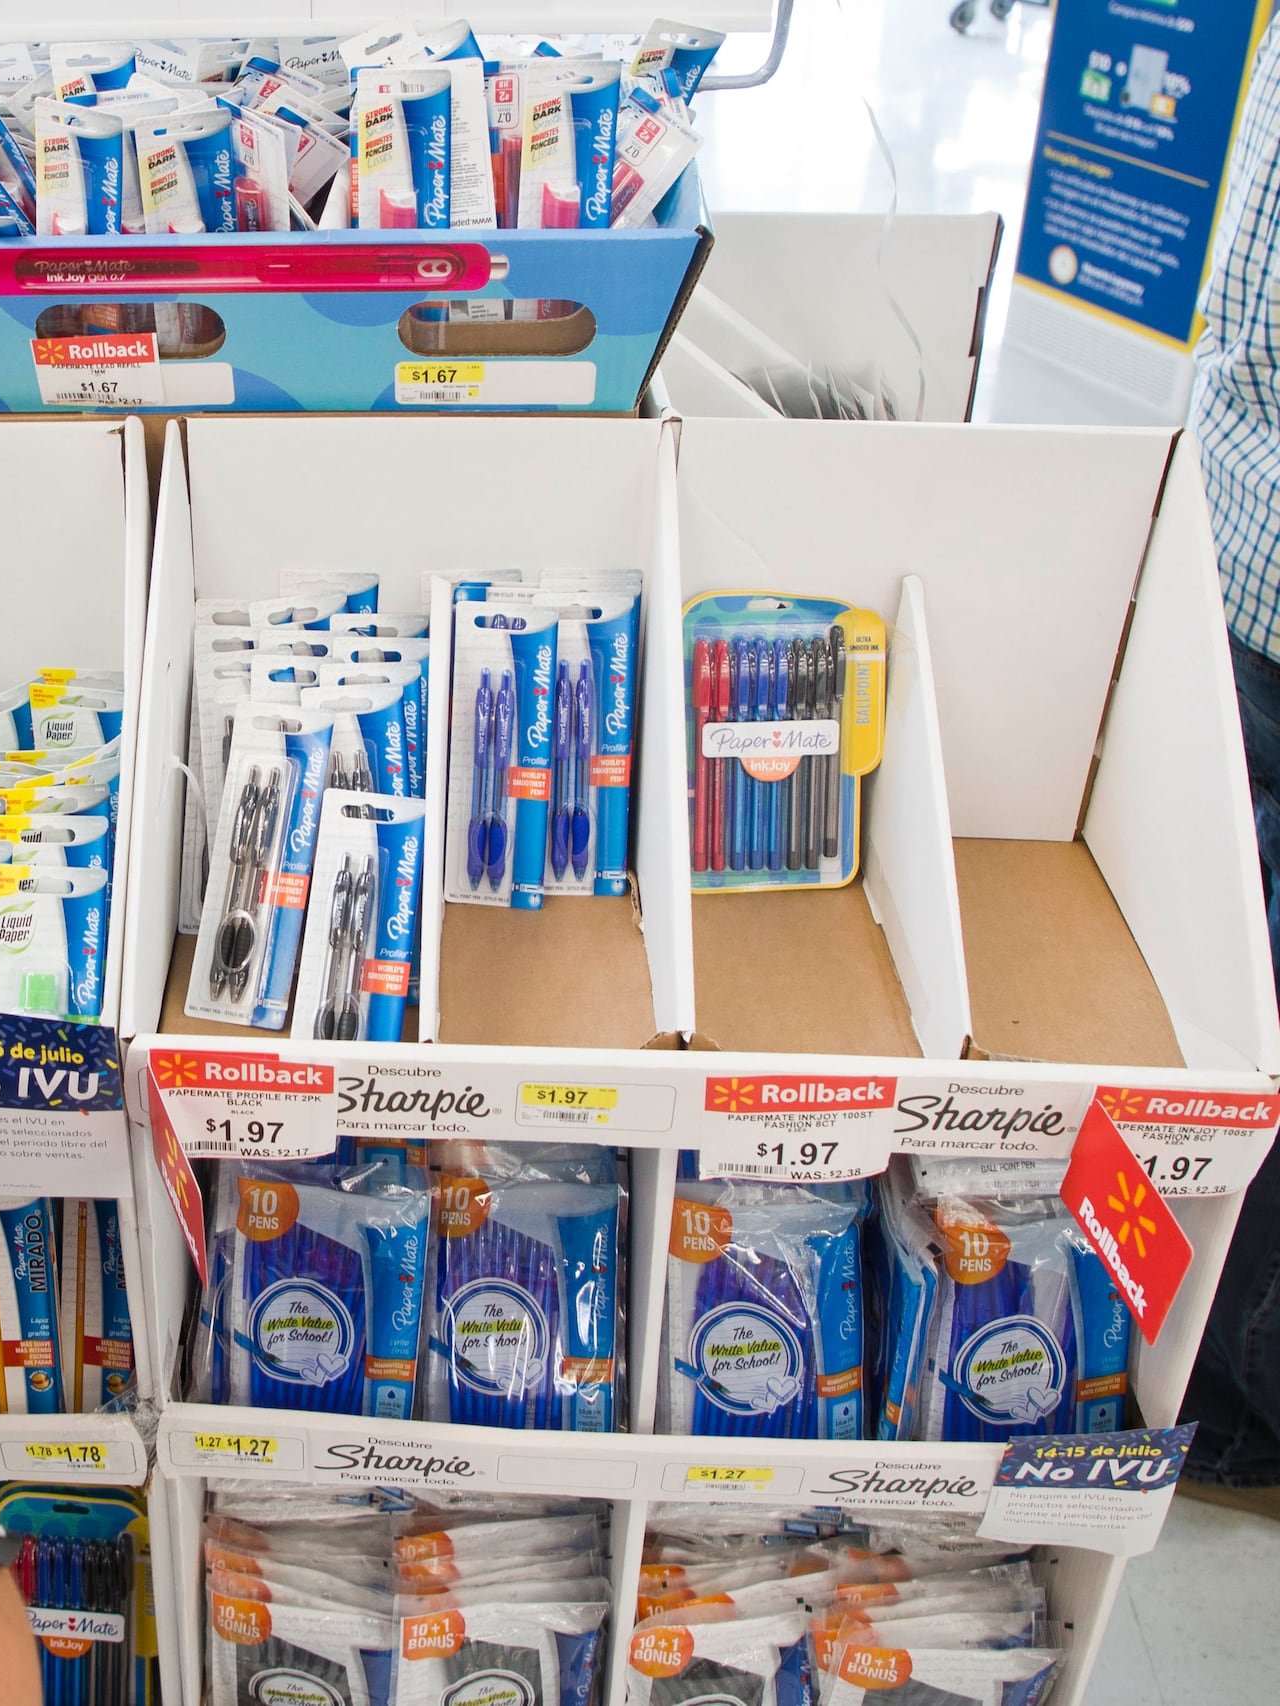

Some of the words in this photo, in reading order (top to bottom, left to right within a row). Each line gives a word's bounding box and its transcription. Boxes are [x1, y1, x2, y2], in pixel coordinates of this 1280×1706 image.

[365, 104, 393, 119] STRONG
[533, 97, 562, 112] STRONG
[366, 111, 393, 128] DARK
[533, 105, 562, 121] DARK
[428, 115, 446, 162] Mate
[594, 109, 613, 156] Mate
[43, 137, 69, 145] STRONG
[44, 143, 70, 152] DARK
[147, 145, 175, 162] STRONG
[148, 152, 177, 169] DARK
[424, 171, 449, 226] Paper
[586, 163, 611, 220] Paper
[34, 260, 85, 272] Paper
[93, 260, 135, 272] Mate
[69, 341, 149, 359] Rollback
[412, 370, 458, 383] $1.67
[81, 382, 118, 393] $1.67
[611, 633, 628, 677] Mate
[535, 645, 551, 690] Mate
[856, 662, 871, 725] BALLPOINT
[606, 682, 628, 736] Paper
[48, 721, 74, 734] Liquid
[527, 694, 551, 748] Paper
[46, 730, 72, 741] Paper
[710, 728, 770, 752] Paper
[782, 733, 832, 749] Mate
[601, 743, 627, 753] Profile
[521, 756, 548, 765] Profile
[750, 760, 791, 772] InkJoy
[398, 836, 417, 879] Mate
[387, 885, 416, 941] Paper
[1, 914, 33, 929] Liquid
[84, 908, 100, 949] Mate
[77, 953, 98, 1005] Paper
[10, 1043, 35, 1059] de
[40, 1045, 84, 1065] julio
[205, 1062, 323, 1085] Rollback
[368, 1065, 441, 1078] Descubre
[18, 1067, 99, 1100] IVU
[948, 1083, 1024, 1096] Descubre
[169, 1090, 232, 1099] PAPERMATE
[236, 1092, 281, 1101] PROFILE
[337, 1077, 491, 1120] Sharpie
[537, 1089, 588, 1105] $1.97
[762, 1082, 885, 1104] Rollback
[227, 1099, 263, 1107] BLACK
[1146, 1098, 1271, 1120] Rollback
[12, 1116, 23, 1124] el
[26, 1117, 47, 1125] IVU
[728, 1112, 796, 1121] PAPERMATE
[798, 1112, 838, 1122] INKJOY
[842, 1111, 872, 1119] 100ST
[894, 1095, 1066, 1139] Sharpie
[11, 1128, 92, 1137] seleccionados
[206, 1118, 284, 1143] $1.97
[336, 1119, 371, 1131] Para
[374, 1121, 429, 1131] marcar
[432, 1121, 470, 1133] todo.
[0, 1138, 9, 1146] el
[61, 1140, 87, 1148] libre
[901, 1138, 937, 1149] Para
[941, 1140, 996, 1150] marcar
[999, 1140, 1039, 1151] todo.
[1142, 1133, 1190, 1141] FASHION
[10, 1149, 42, 1158] sobre
[240, 1148, 274, 1156] WAS:
[278, 1148, 309, 1156] $2.17
[757, 1141, 839, 1166] $1.97
[791, 1170, 828, 1180] WAS:
[829, 1168, 861, 1178] $2.38
[444, 1186, 470, 1211] 10
[1158, 1186, 1192, 1195] WAS:
[1195, 1186, 1226, 1194] $2.38
[250, 1189, 277, 1214] 10
[249, 1216, 279, 1230] PENS
[682, 1211, 710, 1235] 10
[684, 1236, 715, 1250] PENS
[959, 1232, 988, 1256] 10
[25, 1214, 47, 1292] MIRADO
[1079, 1197, 1148, 1319] Rollback
[959, 1258, 991, 1272] PENS
[289, 1301, 309, 1314] The
[484, 1304, 504, 1316] The
[267, 1318, 299, 1330] Write
[301, 1317, 333, 1329] Value
[267, 1333, 285, 1350] for
[287, 1332, 333, 1343] School!
[734, 1327, 753, 1340] The
[710, 1344, 743, 1356] Write
[747, 1342, 781, 1353] Value
[1001, 1341, 1018, 1353] The
[712, 1360, 732, 1376] for
[735, 1353, 781, 1369] School!
[977, 1356, 1009, 1371] Write
[1011, 1350, 1043, 1364] Value
[977, 1374, 996, 1389] for
[999, 1362, 1044, 1382] School!
[195, 1436, 222, 1448] $1.27
[227, 1439, 270, 1457] $1.27
[368, 1438, 432, 1449] Descubre
[25, 1446, 52, 1456] $1.78
[58, 1446, 101, 1462] $1.78
[1036, 1447, 1085, 1459] 14-15
[1091, 1446, 1114, 1456] de
[1117, 1445, 1162, 1459] julio
[315, 1444, 475, 1477] Sharpie
[875, 1462, 942, 1470] Descubre
[700, 1470, 746, 1480] $1.27
[1015, 1461, 1074, 1481] No
[1087, 1459, 1171, 1483] IVU
[811, 1470, 978, 1498] Sharpie
[26, 1611, 68, 1630] Paper
[76, 1619, 119, 1636] Mate
[50, 1639, 84, 1651] InkJoy
[408, 1633, 455, 1650] BONUS
[847, 1662, 898, 1682] BONUS
